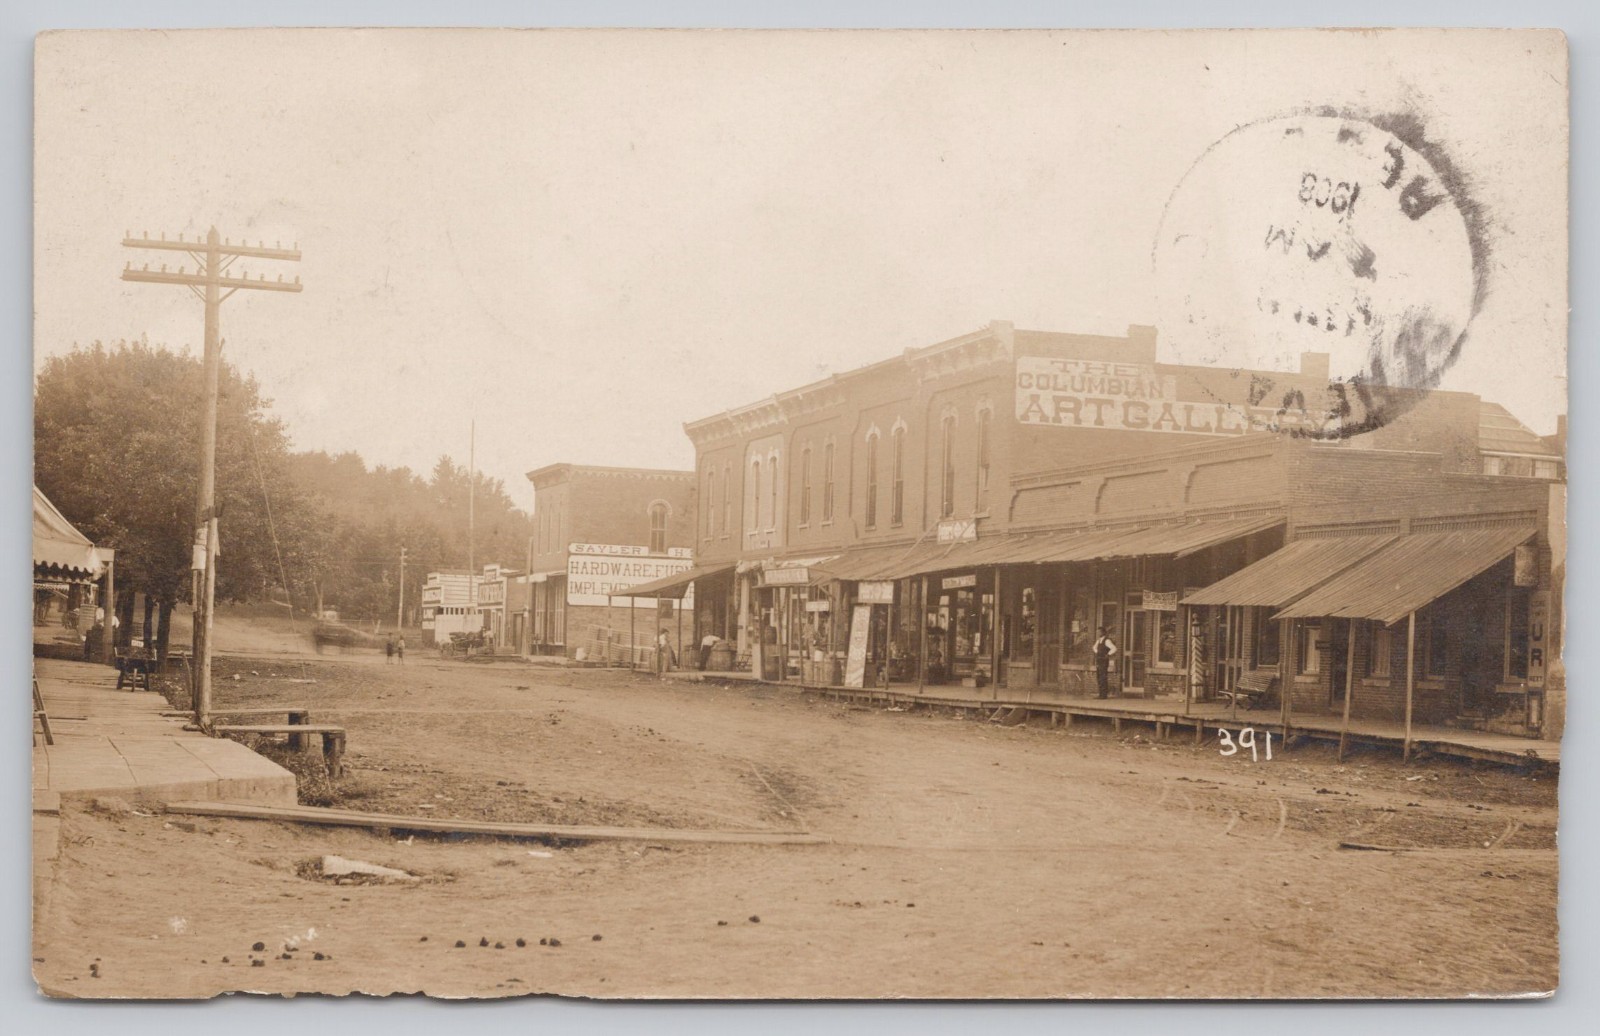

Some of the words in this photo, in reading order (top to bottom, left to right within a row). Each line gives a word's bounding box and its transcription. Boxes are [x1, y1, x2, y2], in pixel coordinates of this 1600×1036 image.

[1051, 360, 1140, 377] THE
[1017, 371, 1164, 400] COLUMBIAN
[1019, 394, 1115, 427] ART
[574, 544, 642, 555] SAYLER
